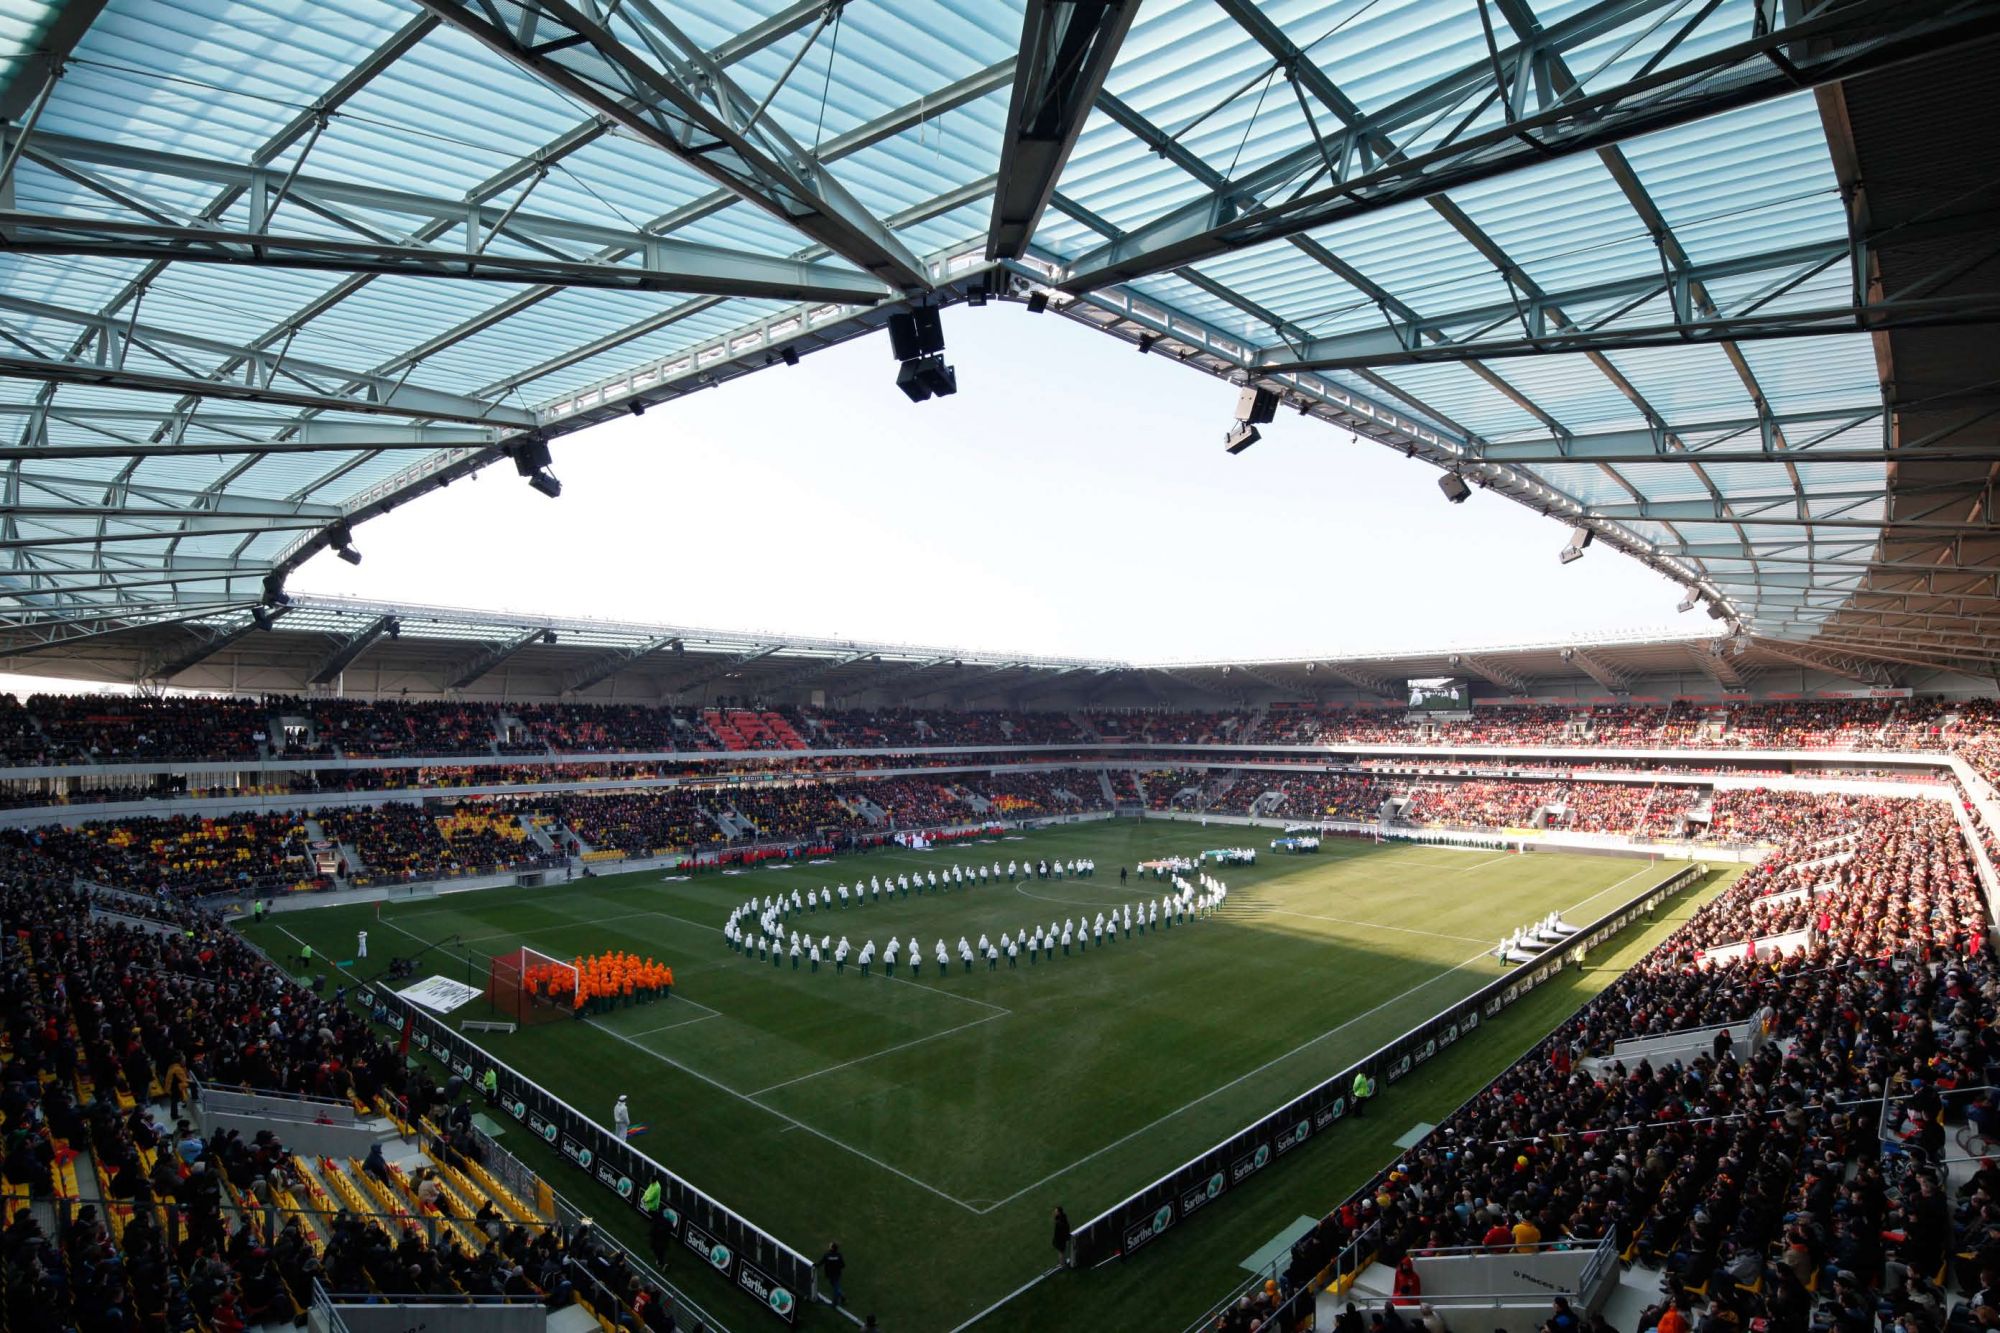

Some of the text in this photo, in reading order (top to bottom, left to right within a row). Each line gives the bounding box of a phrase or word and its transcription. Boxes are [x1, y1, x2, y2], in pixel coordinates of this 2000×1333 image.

[600, 1167, 617, 1190] Sarthe
[1234, 1162, 1254, 1180] Sarthe
[1184, 1192, 1206, 1211] Sarthe
[687, 1231, 710, 1256] Sarthe
[1127, 1227, 1152, 1249] Sarthe
[741, 1271, 768, 1299] Sarthe
